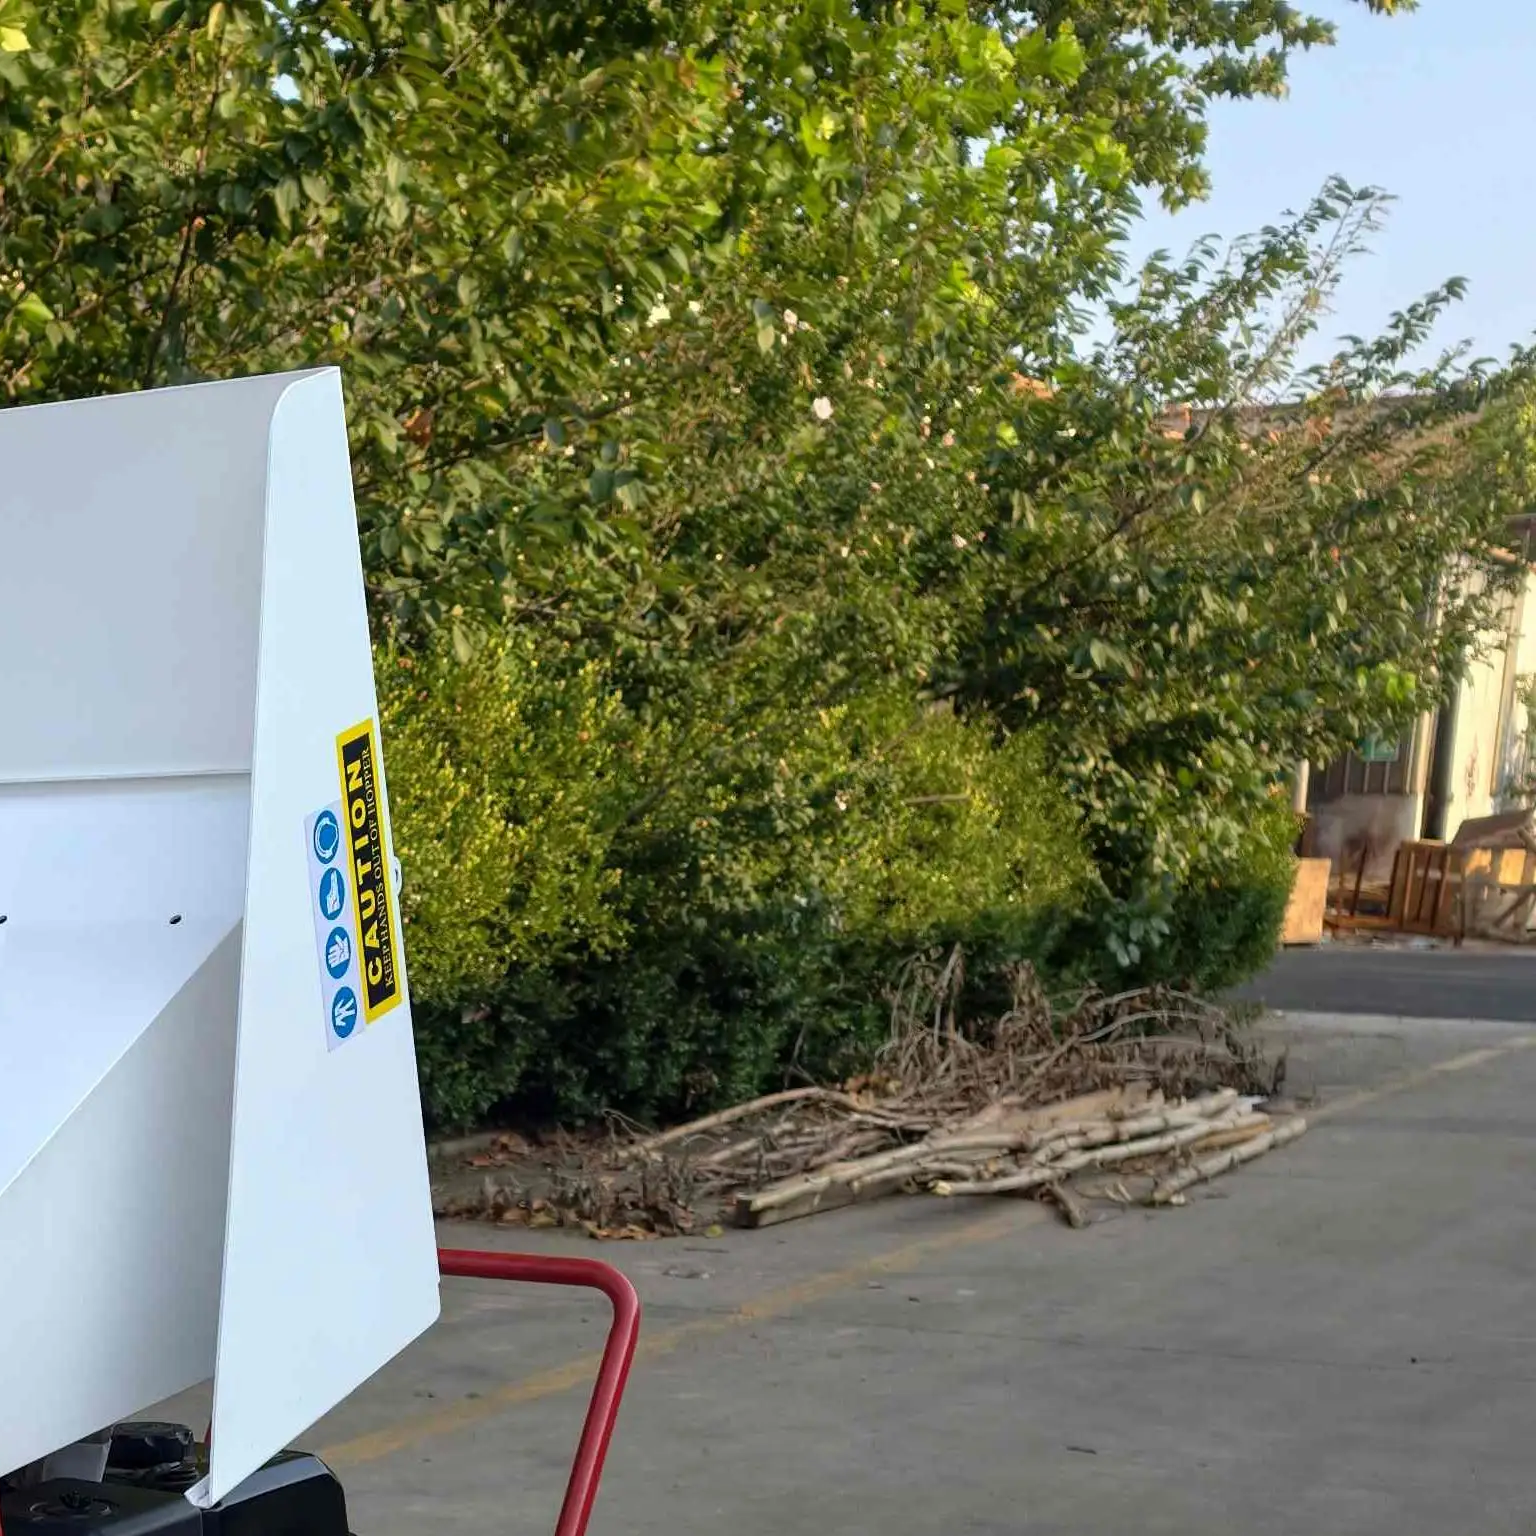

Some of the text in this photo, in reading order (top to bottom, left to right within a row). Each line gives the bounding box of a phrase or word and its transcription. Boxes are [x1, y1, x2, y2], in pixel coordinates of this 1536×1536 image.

[347, 760, 382, 985] CAUTION
[362, 746, 394, 987] KEEP HANDS OUT OF HOPPER
